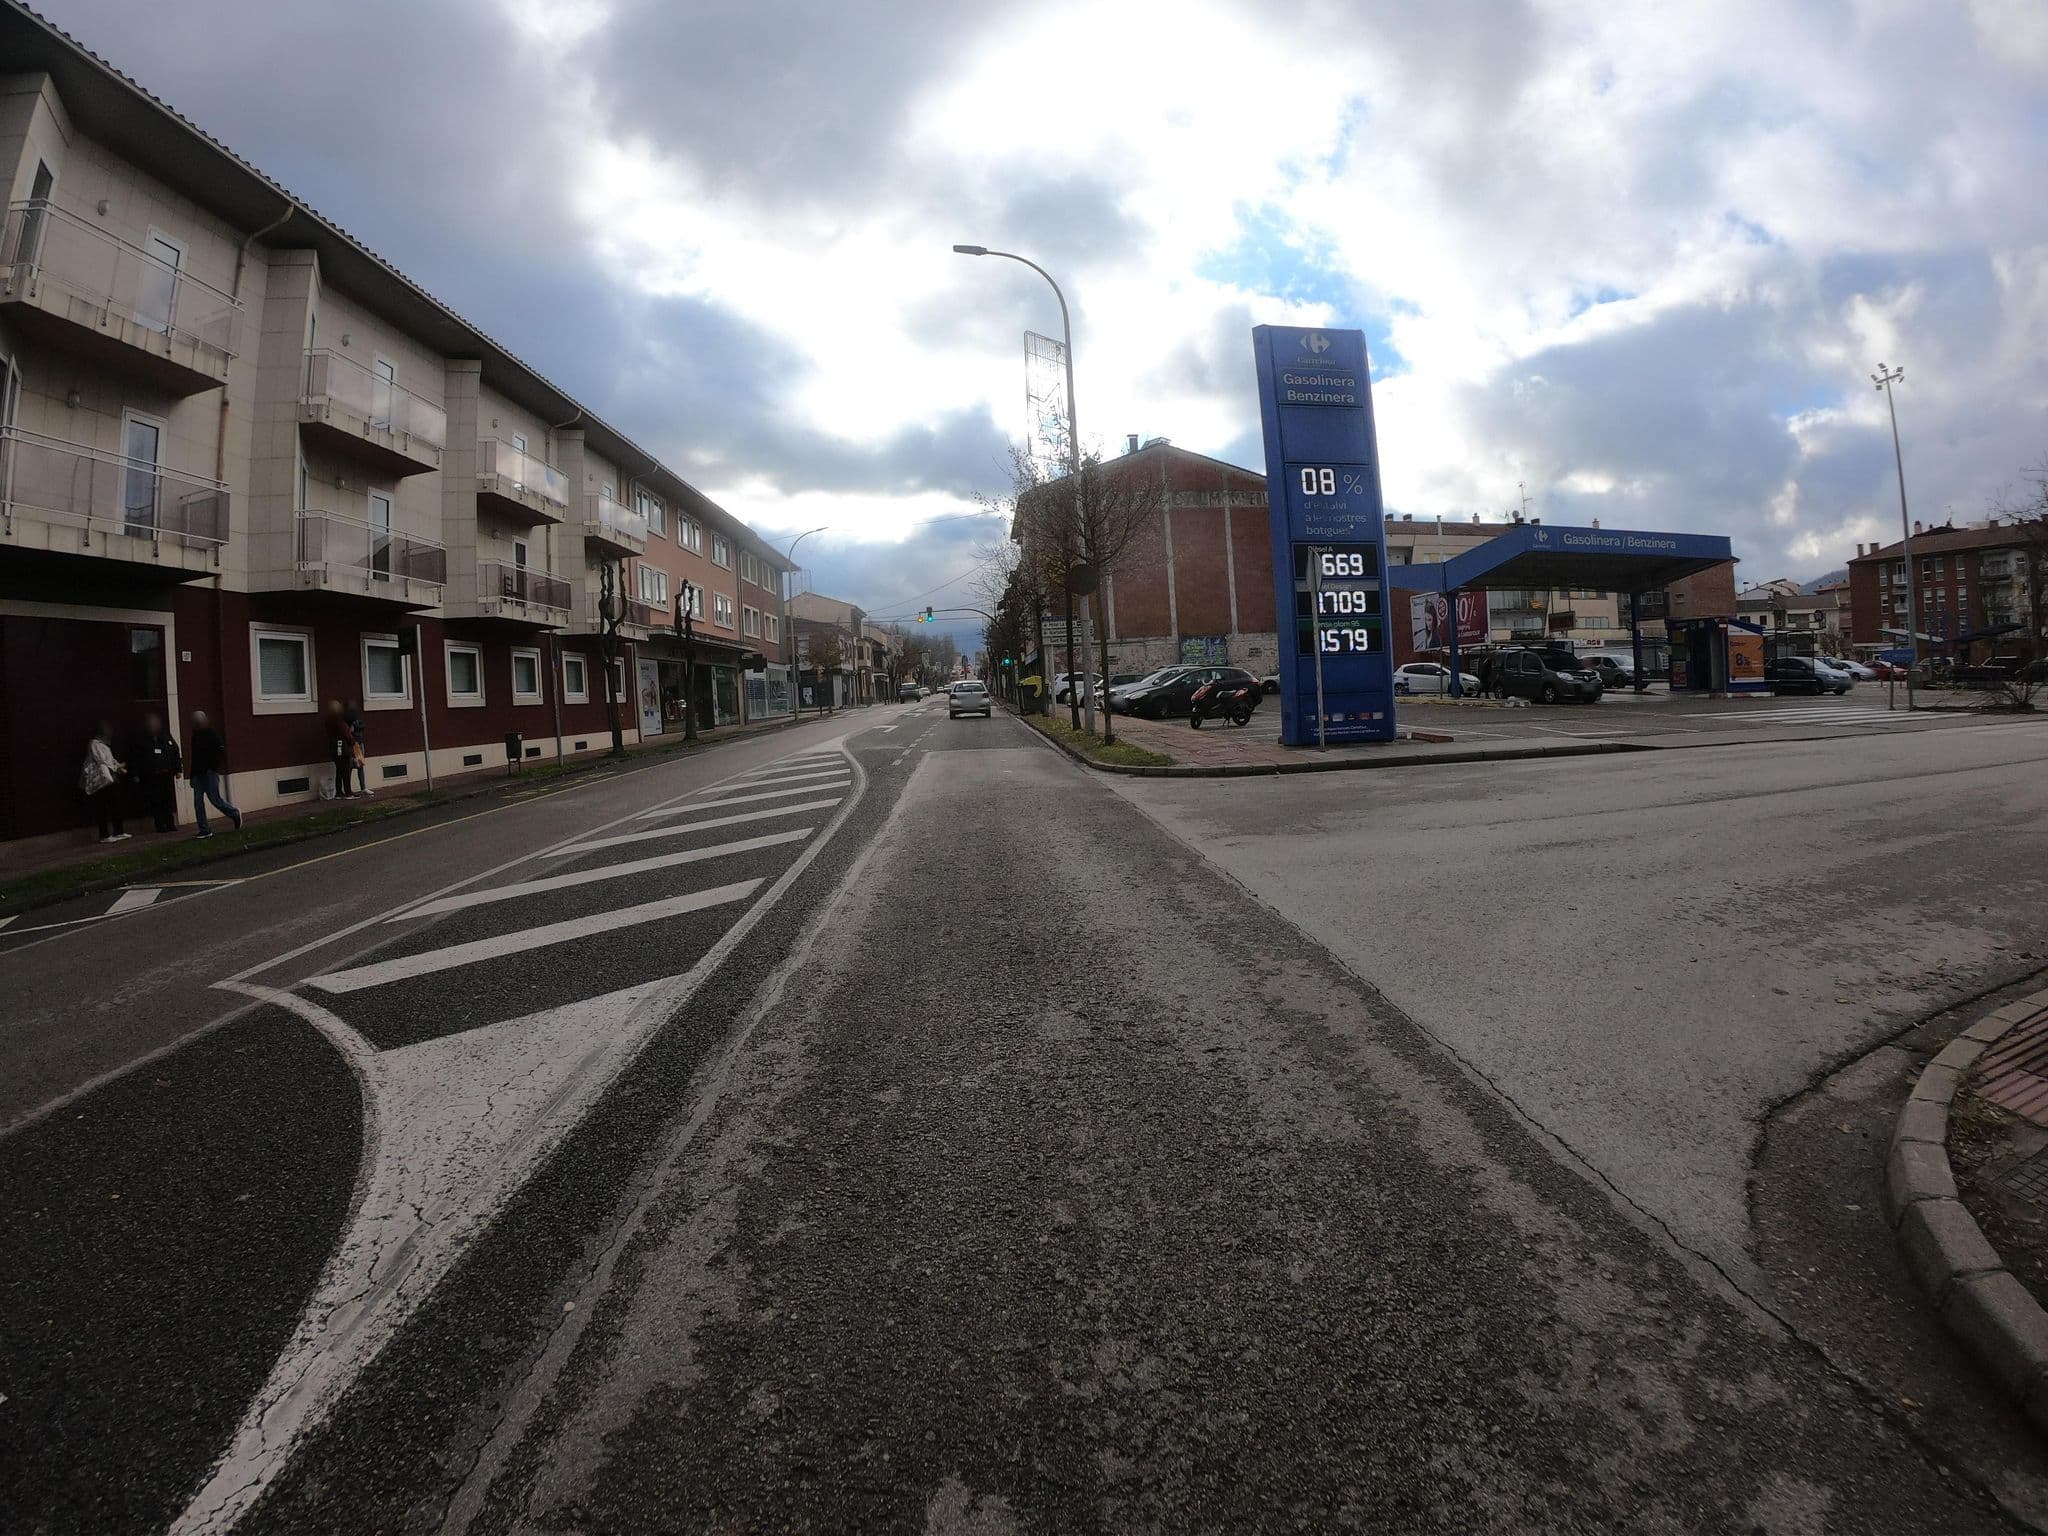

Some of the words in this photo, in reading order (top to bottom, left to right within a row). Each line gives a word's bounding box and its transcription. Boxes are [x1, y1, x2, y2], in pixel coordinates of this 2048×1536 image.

[1283, 373, 1355, 387] Gasolinera
[1287, 389, 1355, 404] Benzinera
[1563, 533, 1620, 547] Gasolinera
[1627, 536, 1677, 549] Benzinera
[1321, 553, 1364, 576] 669
